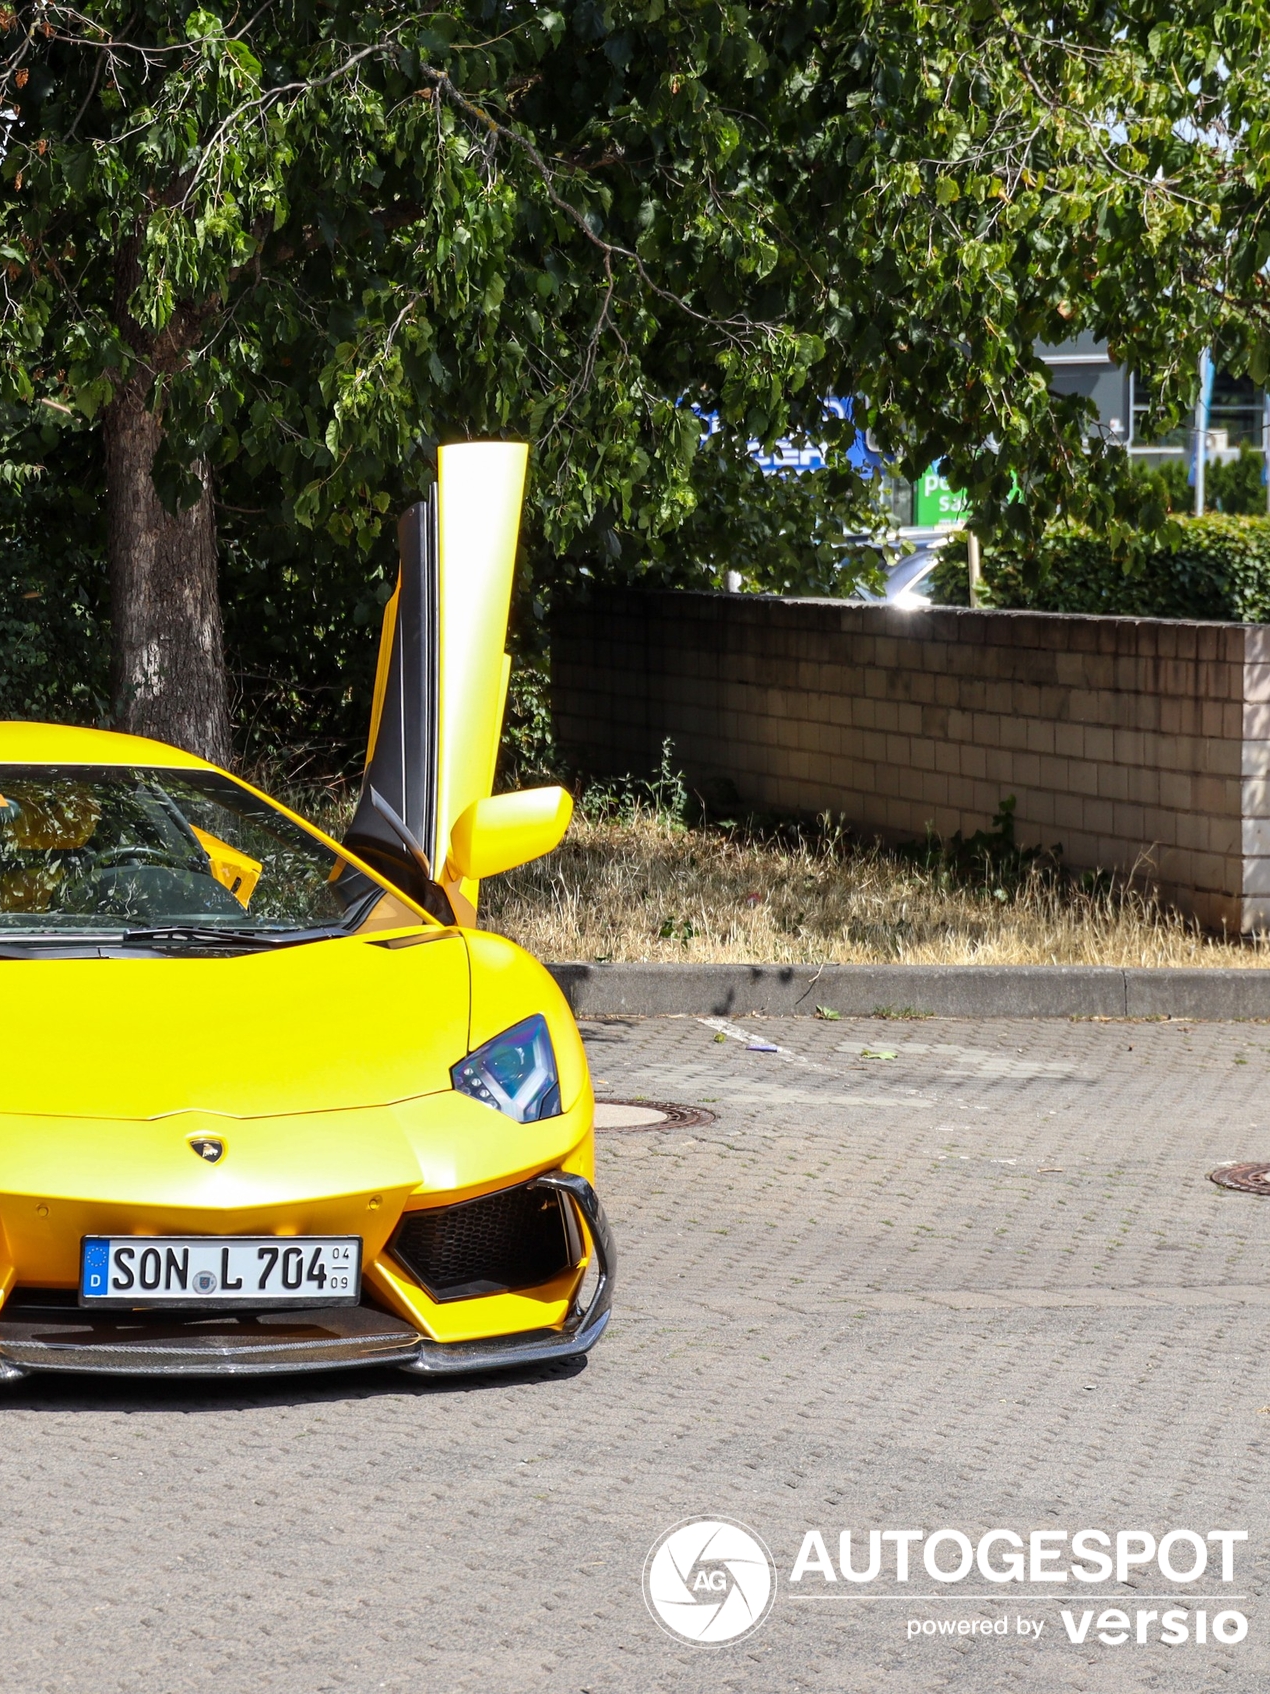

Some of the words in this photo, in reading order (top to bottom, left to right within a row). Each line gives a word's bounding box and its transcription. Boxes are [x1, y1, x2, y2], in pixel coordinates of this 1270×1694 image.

[332, 1247, 350, 1260] 04
[112, 1246, 189, 1290] SON
[220, 1247, 242, 1290] L
[257, 1247, 327, 1290] 704
[90, 1274, 101, 1287] D
[331, 1276, 348, 1289] 09
